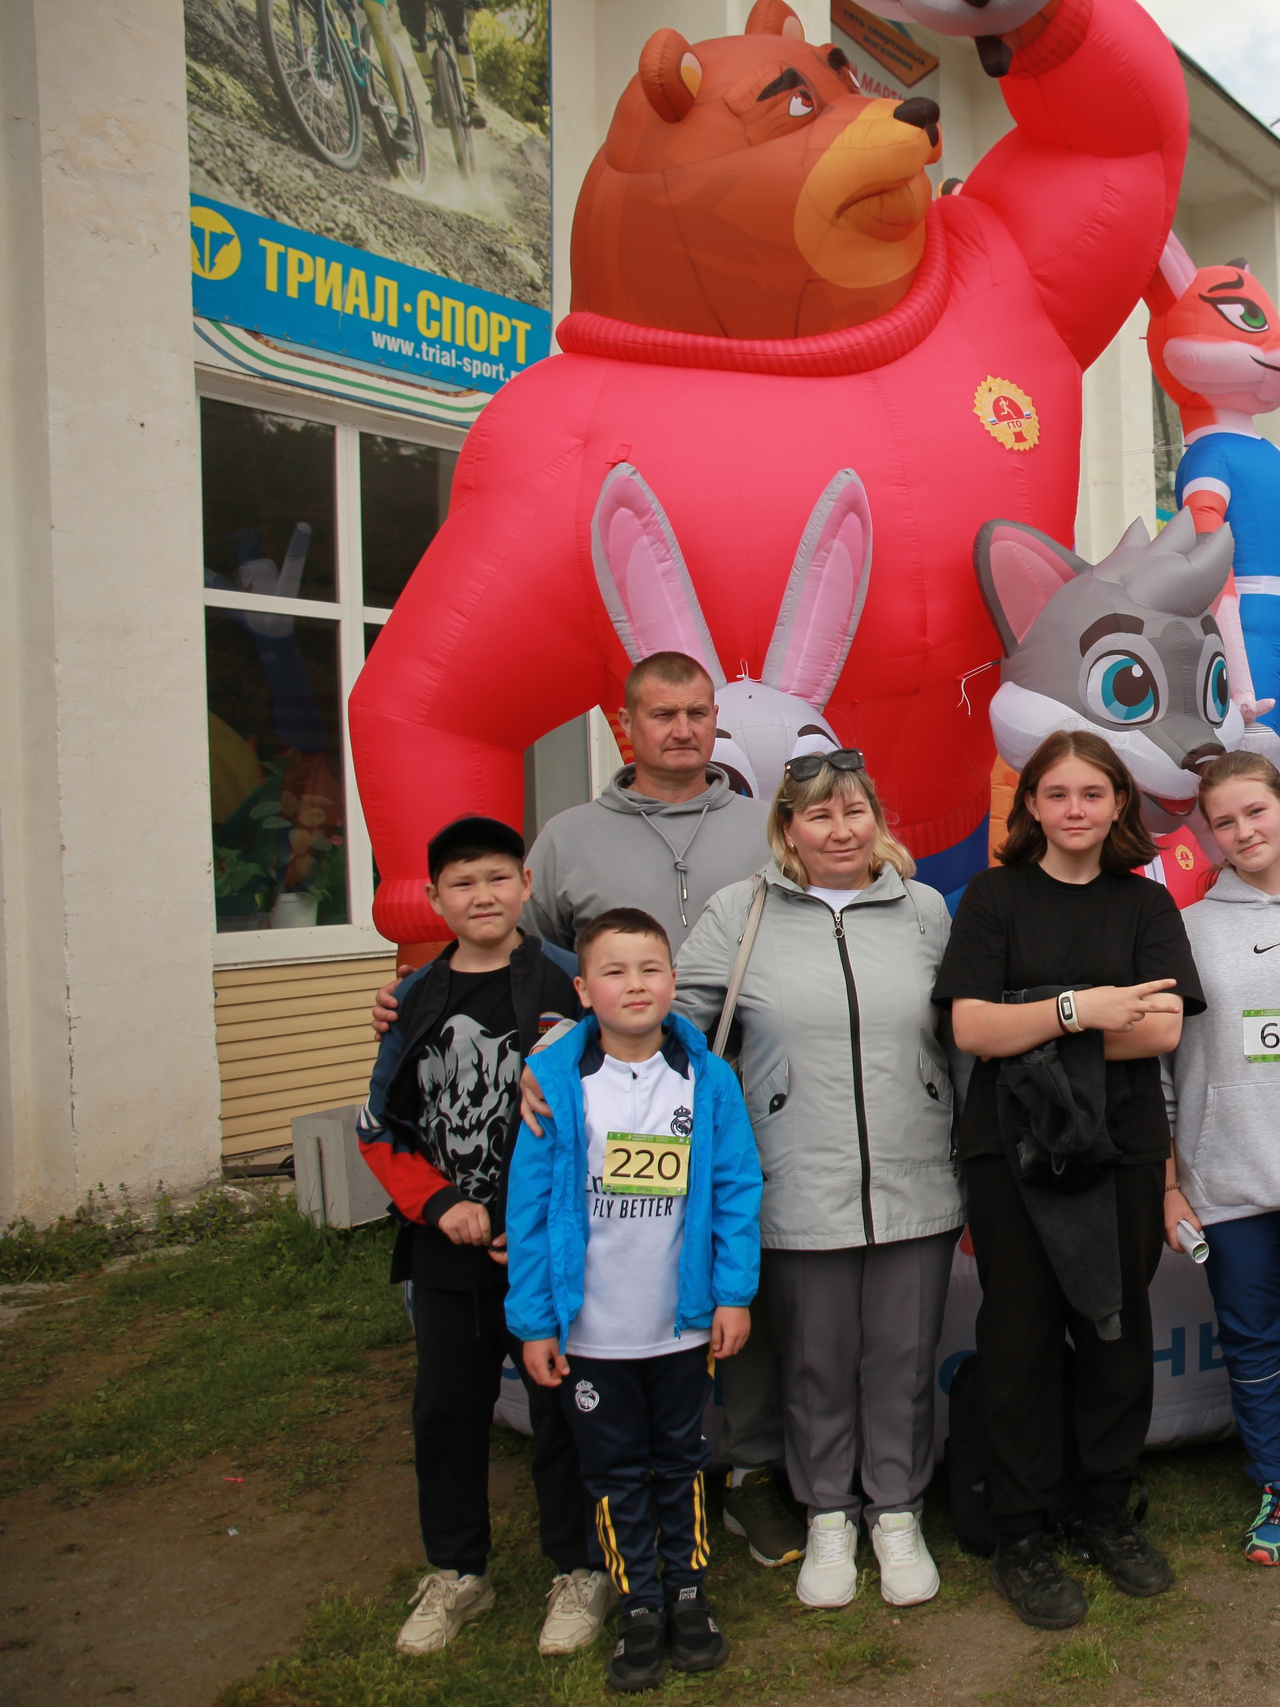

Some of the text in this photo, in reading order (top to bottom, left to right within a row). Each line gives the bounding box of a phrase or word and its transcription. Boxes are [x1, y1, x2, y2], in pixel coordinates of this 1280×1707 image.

[1007, 420, 1022, 429] ГТО
[610, 1147, 681, 1181] 220
[593, 1197, 674, 1218] FLY BETTER
